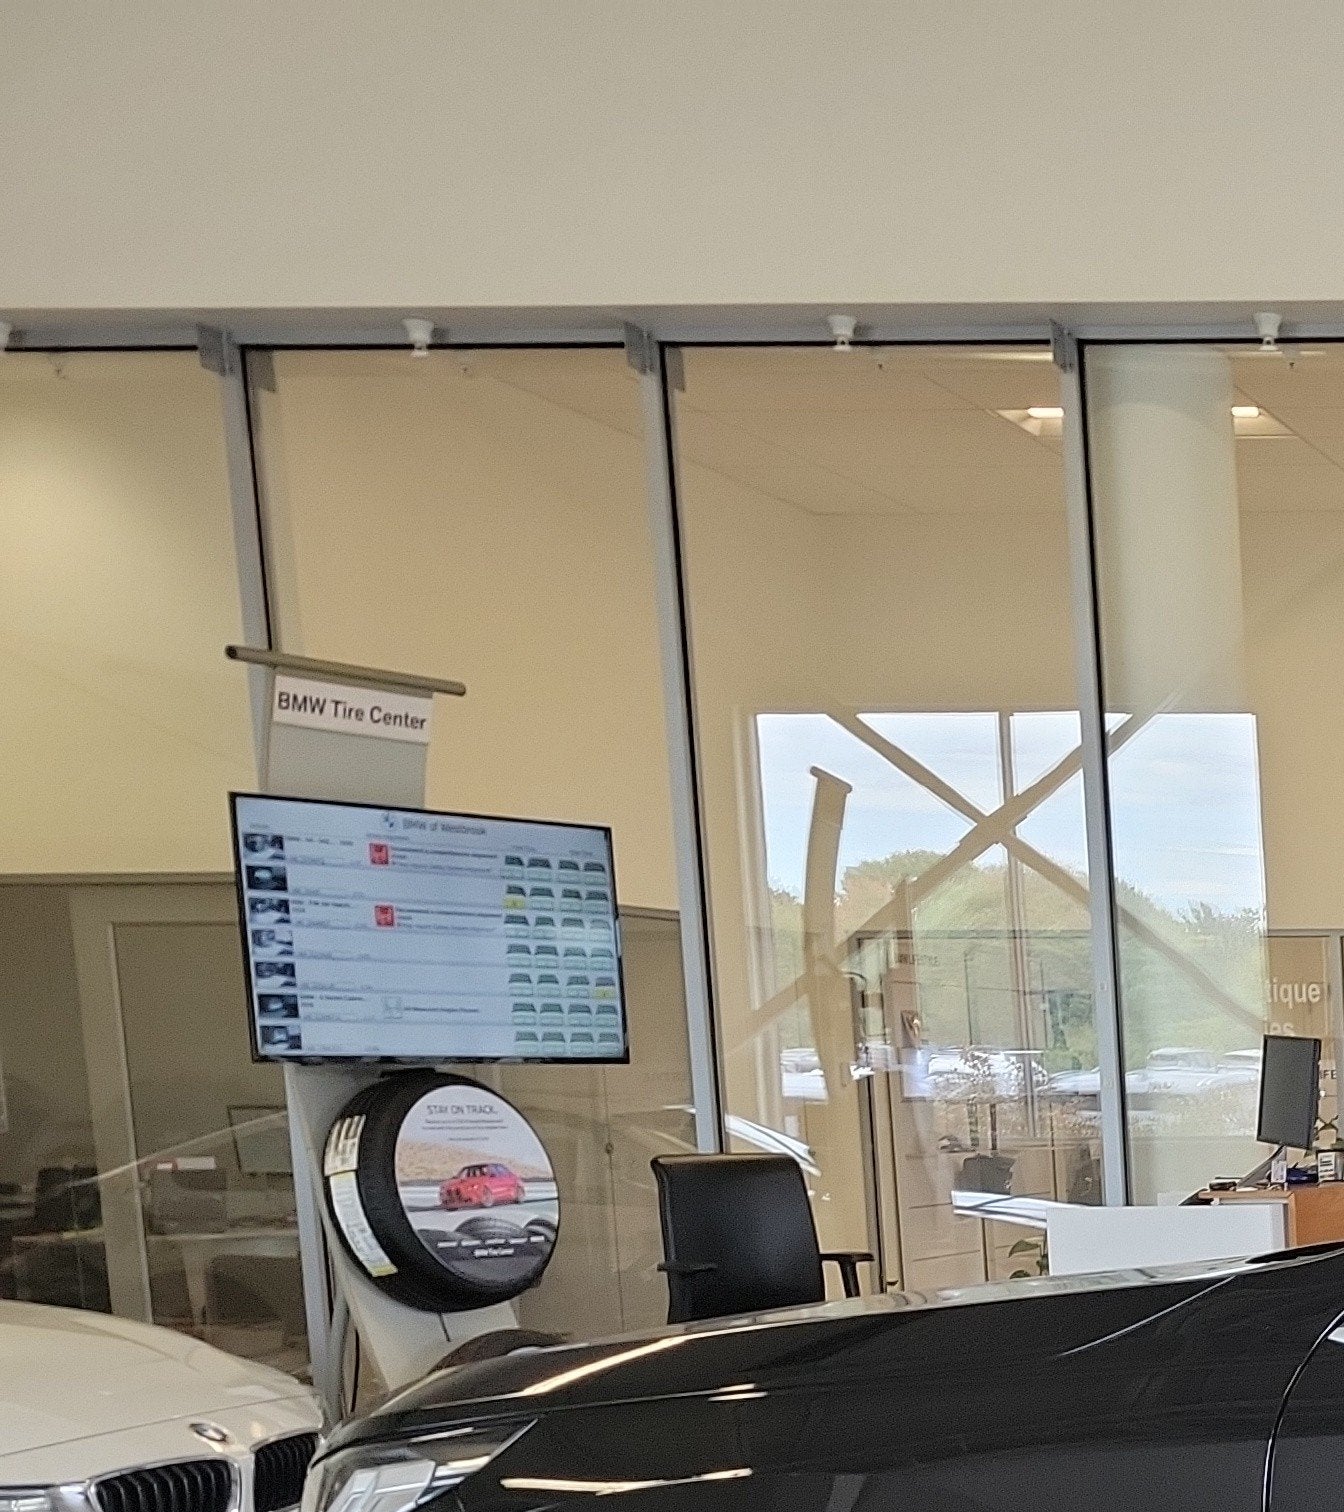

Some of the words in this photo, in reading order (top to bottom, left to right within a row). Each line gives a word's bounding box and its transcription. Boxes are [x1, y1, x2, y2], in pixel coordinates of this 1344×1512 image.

[277, 691, 327, 716] BMW
[332, 699, 364, 722] Tire
[369, 705, 427, 730] Center
[451, 1104, 464, 1115] ON
